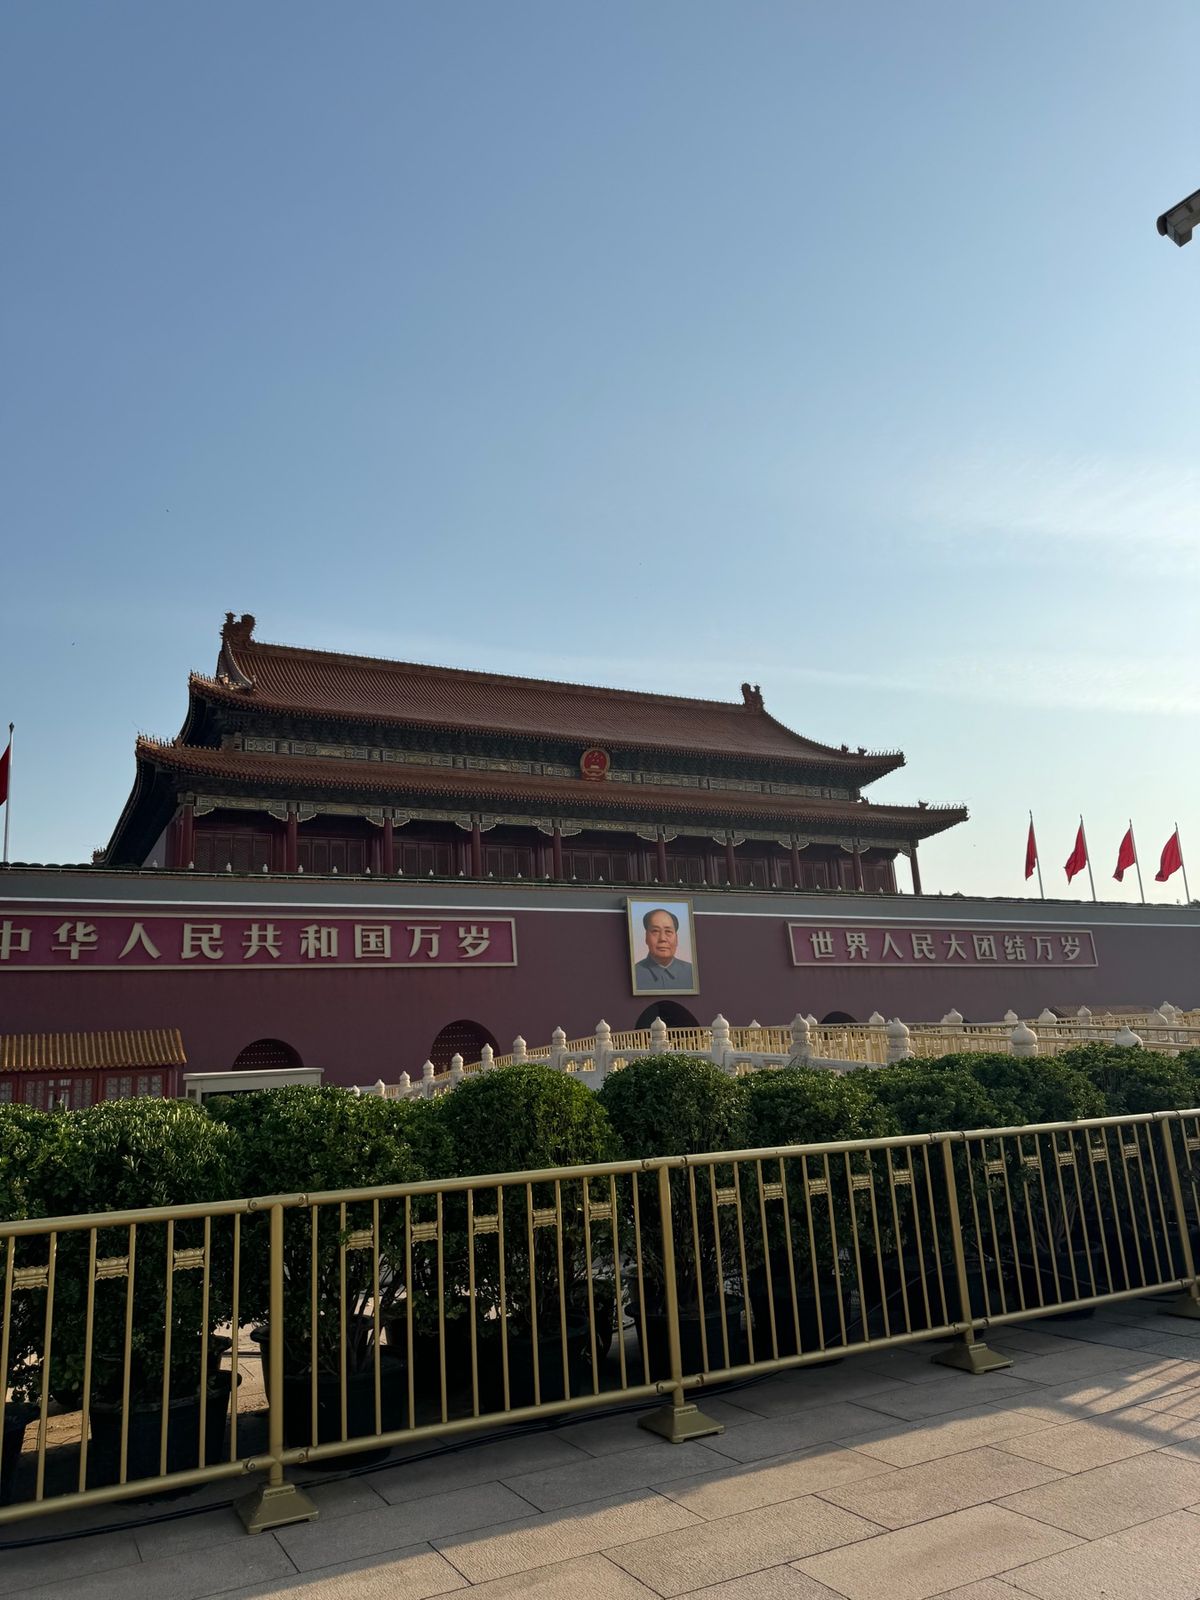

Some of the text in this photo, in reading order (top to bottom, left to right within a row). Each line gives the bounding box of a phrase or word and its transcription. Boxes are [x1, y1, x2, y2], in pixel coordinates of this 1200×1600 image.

[0, 920, 491, 960] 中华人民共和国万岁
[810, 931, 1081, 961] 世界人民大团结万岁
